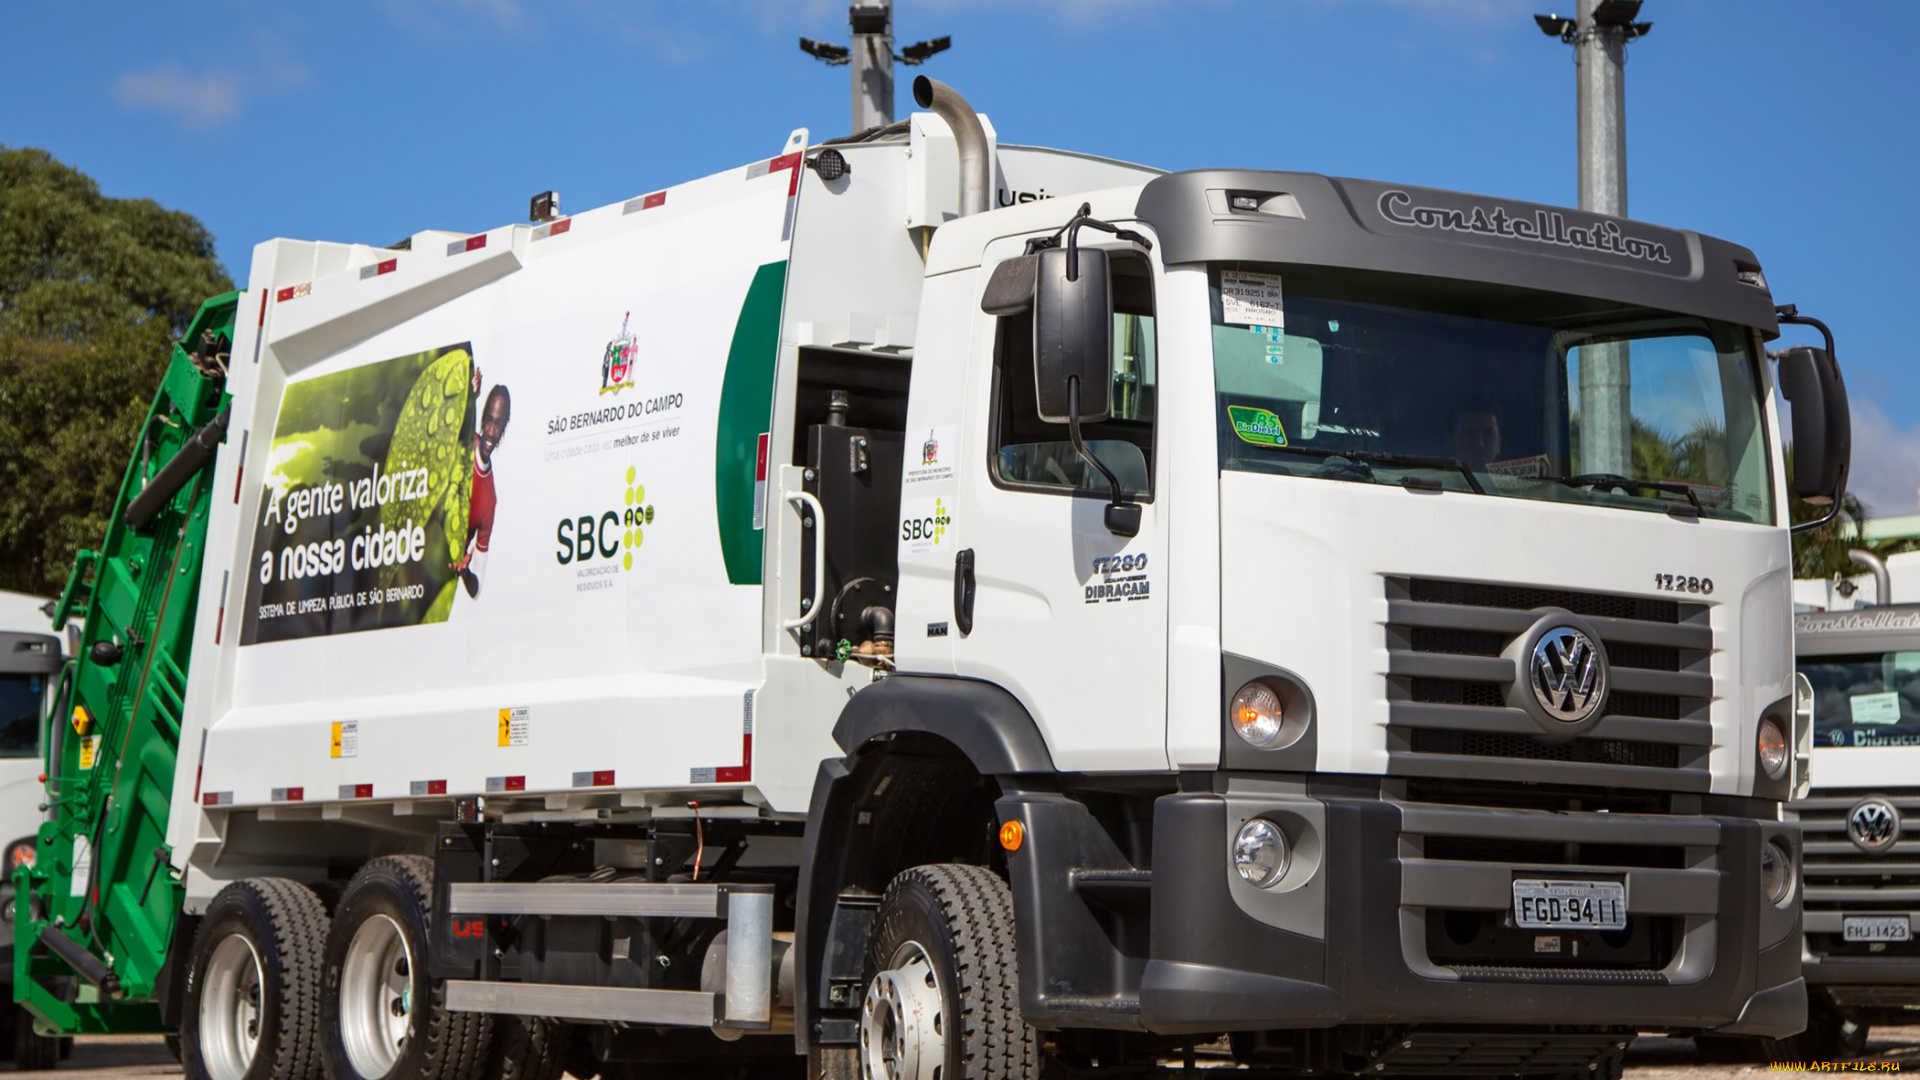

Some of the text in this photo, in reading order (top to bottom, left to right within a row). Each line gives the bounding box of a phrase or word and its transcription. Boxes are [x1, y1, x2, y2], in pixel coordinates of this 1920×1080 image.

[1377, 190, 1671, 264] Constellation
[547, 392, 683, 434] SÃO BERNARDO DO CAMPO
[1236, 421, 1280, 436] BioDiesel
[613, 434, 638, 448] melhor
[640, 431, 650, 443] de
[651, 430, 660, 441] se
[662, 426, 681, 439] viver
[263, 460, 428, 534] A gente valoriza
[556, 510, 620, 565] SBC
[902, 517, 934, 541] SBC
[260, 518, 426, 585] a nossa cidade
[259, 584, 424, 620] SISTEMA DE LIMPEZA PÚBLICA DE SÃO BERNARDO
[1085, 581, 1150, 600] DIBRACAM
